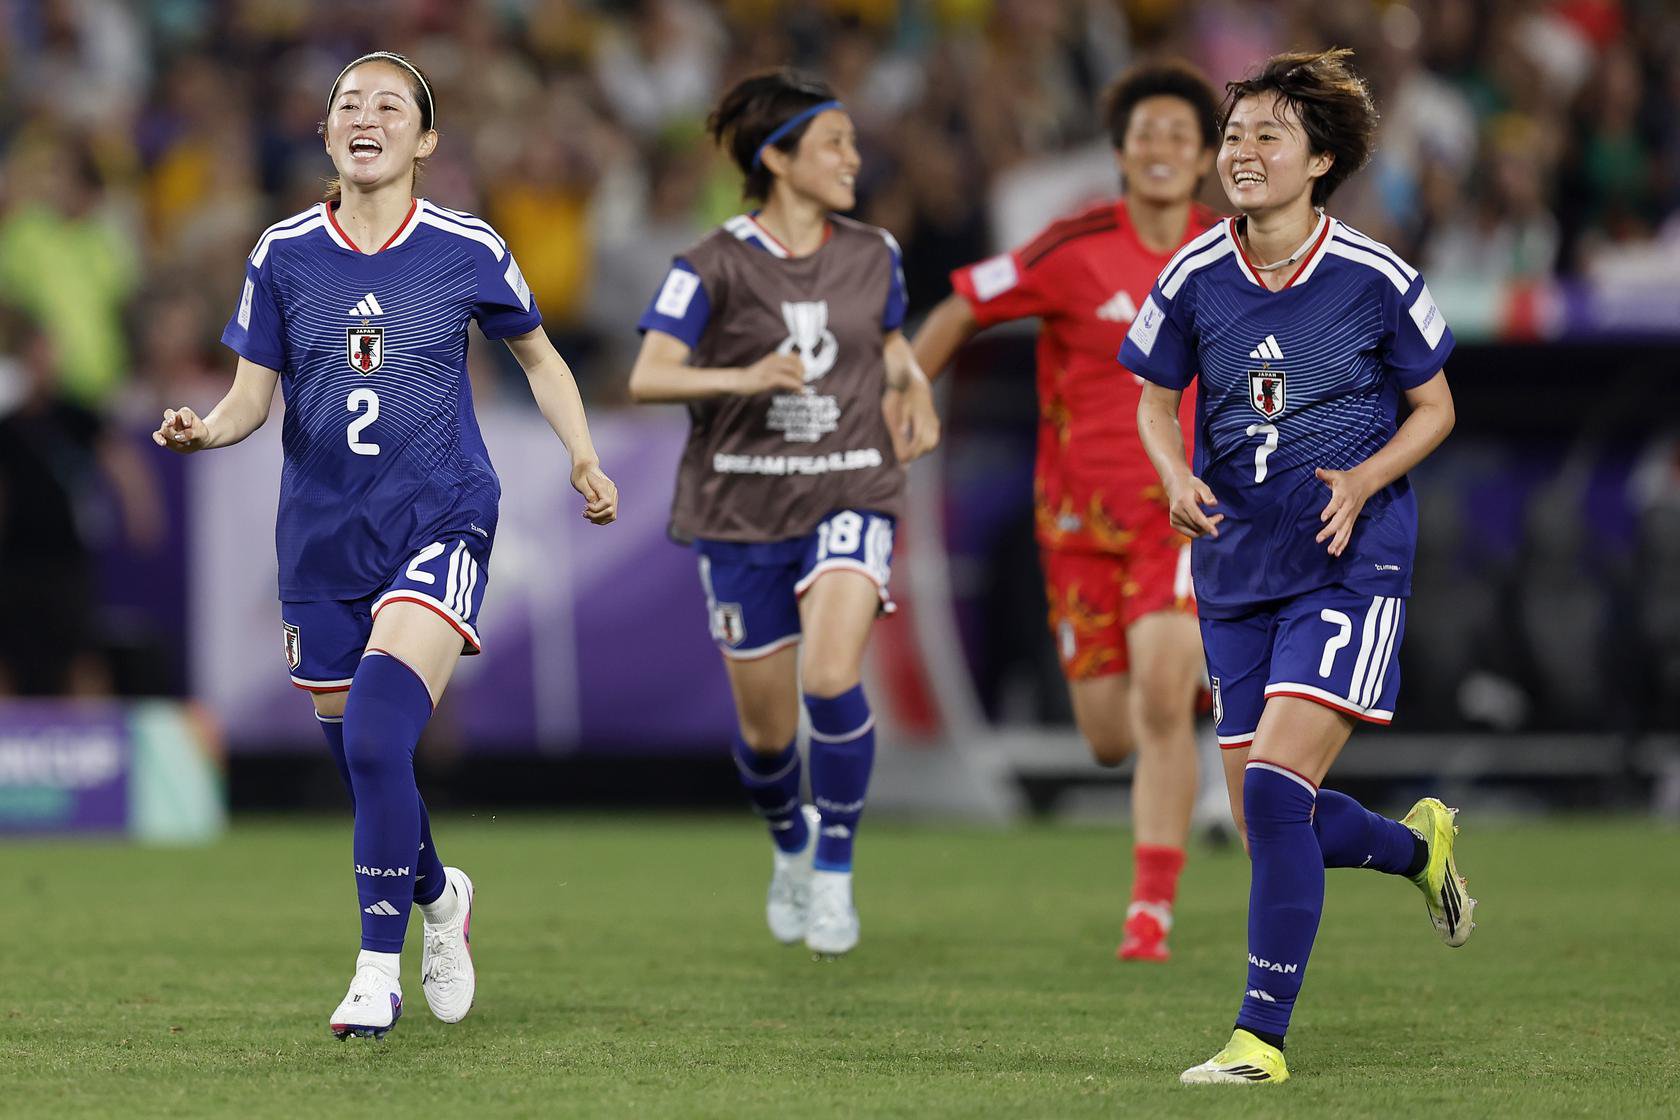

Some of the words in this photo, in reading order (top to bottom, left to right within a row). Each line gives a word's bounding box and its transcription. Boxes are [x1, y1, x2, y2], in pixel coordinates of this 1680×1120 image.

[346, 388, 380, 456] 2
[713, 453, 787, 475] DREAM
[1246, 423, 1279, 483] 7
[816, 509, 864, 562] 18
[405, 541, 446, 585] 2
[1319, 608, 1352, 679] 7
[355, 864, 409, 877] JAPAN
